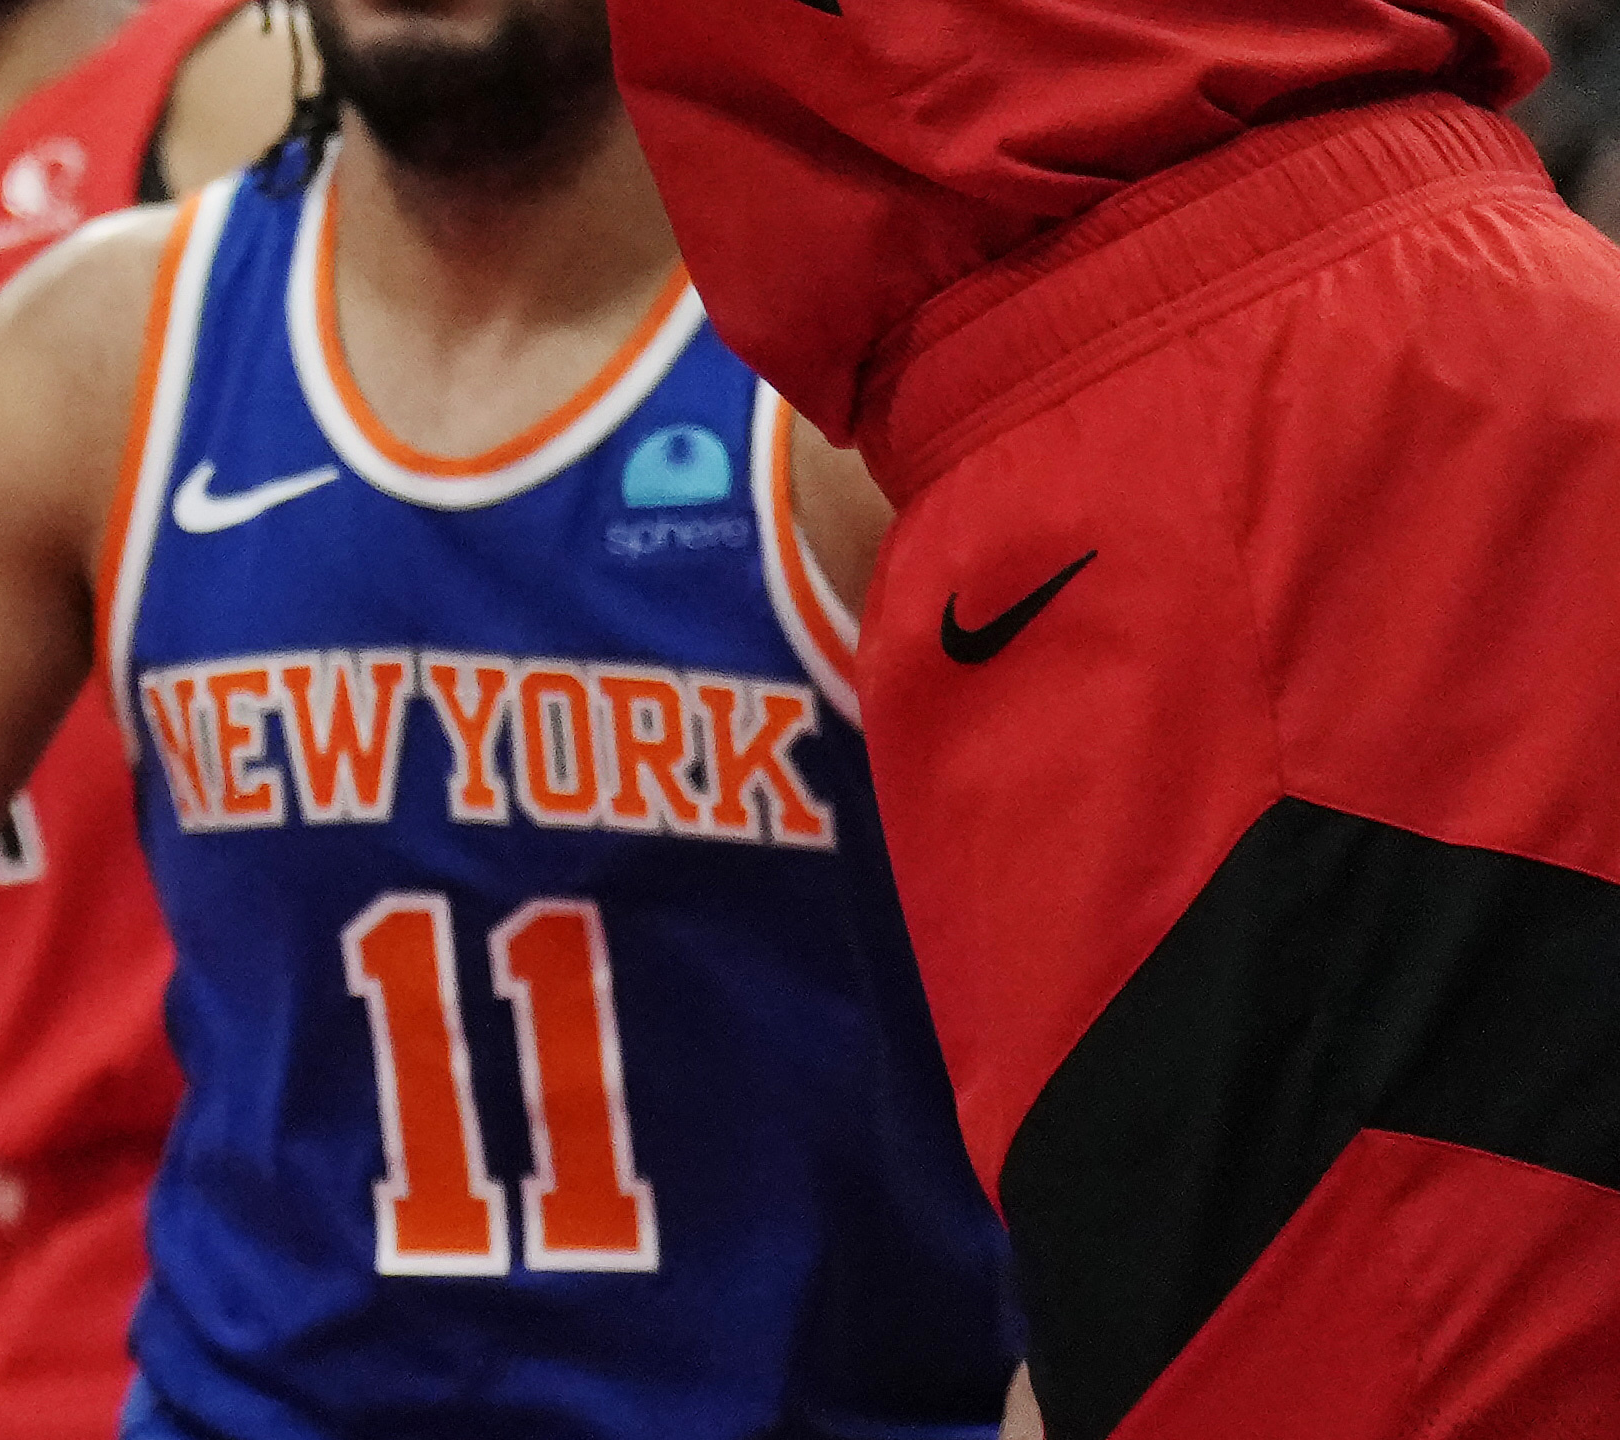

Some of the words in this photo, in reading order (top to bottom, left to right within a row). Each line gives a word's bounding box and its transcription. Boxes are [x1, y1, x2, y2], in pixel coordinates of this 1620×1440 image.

[141, 648, 416, 834] NEW
[418, 653, 837, 852] YORK
[341, 890, 659, 1275] 11
